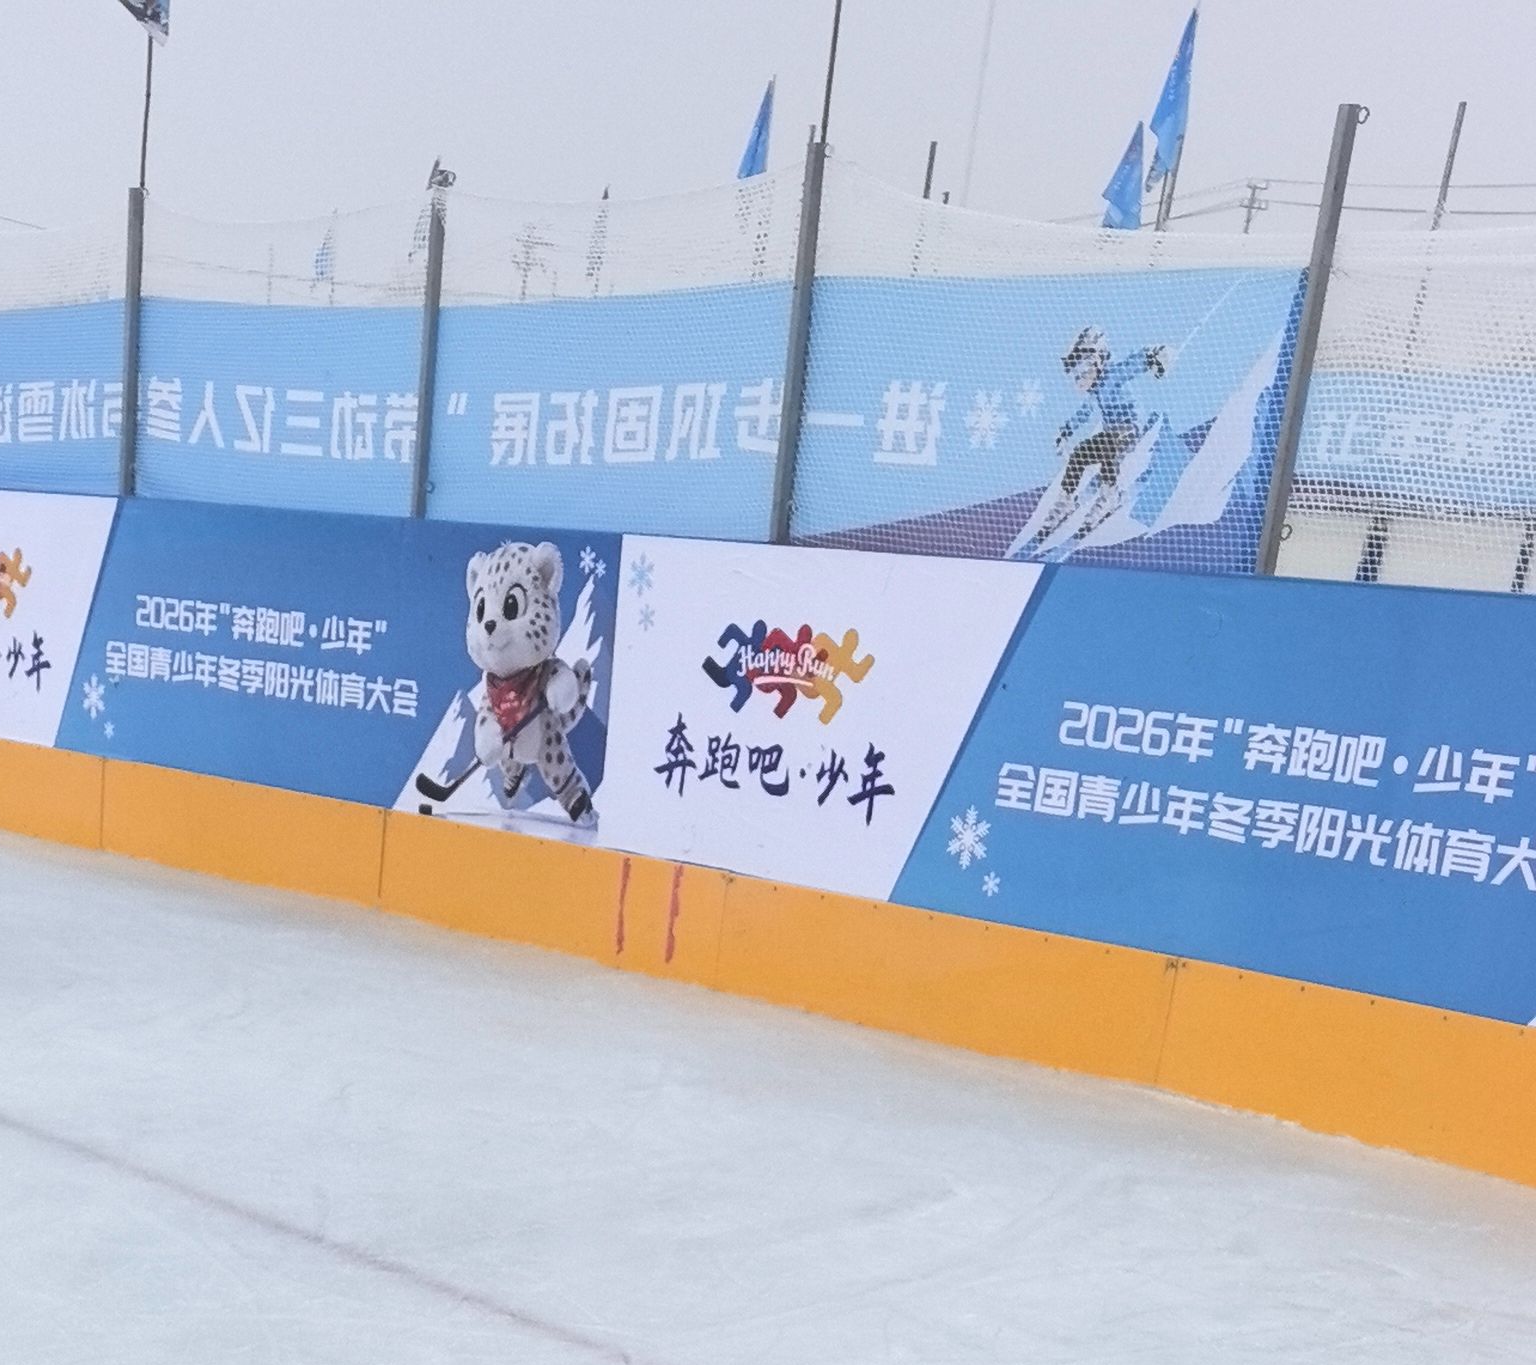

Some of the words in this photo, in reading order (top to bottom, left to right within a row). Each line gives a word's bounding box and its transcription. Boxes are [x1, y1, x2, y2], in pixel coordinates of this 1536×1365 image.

[104, 640, 419, 718] 全国青少年冬季阳光体育大会
[736, 644, 797, 677] Happy
[796, 642, 836, 681] Run
[653, 711, 896, 826] 奔跑吧·少年
